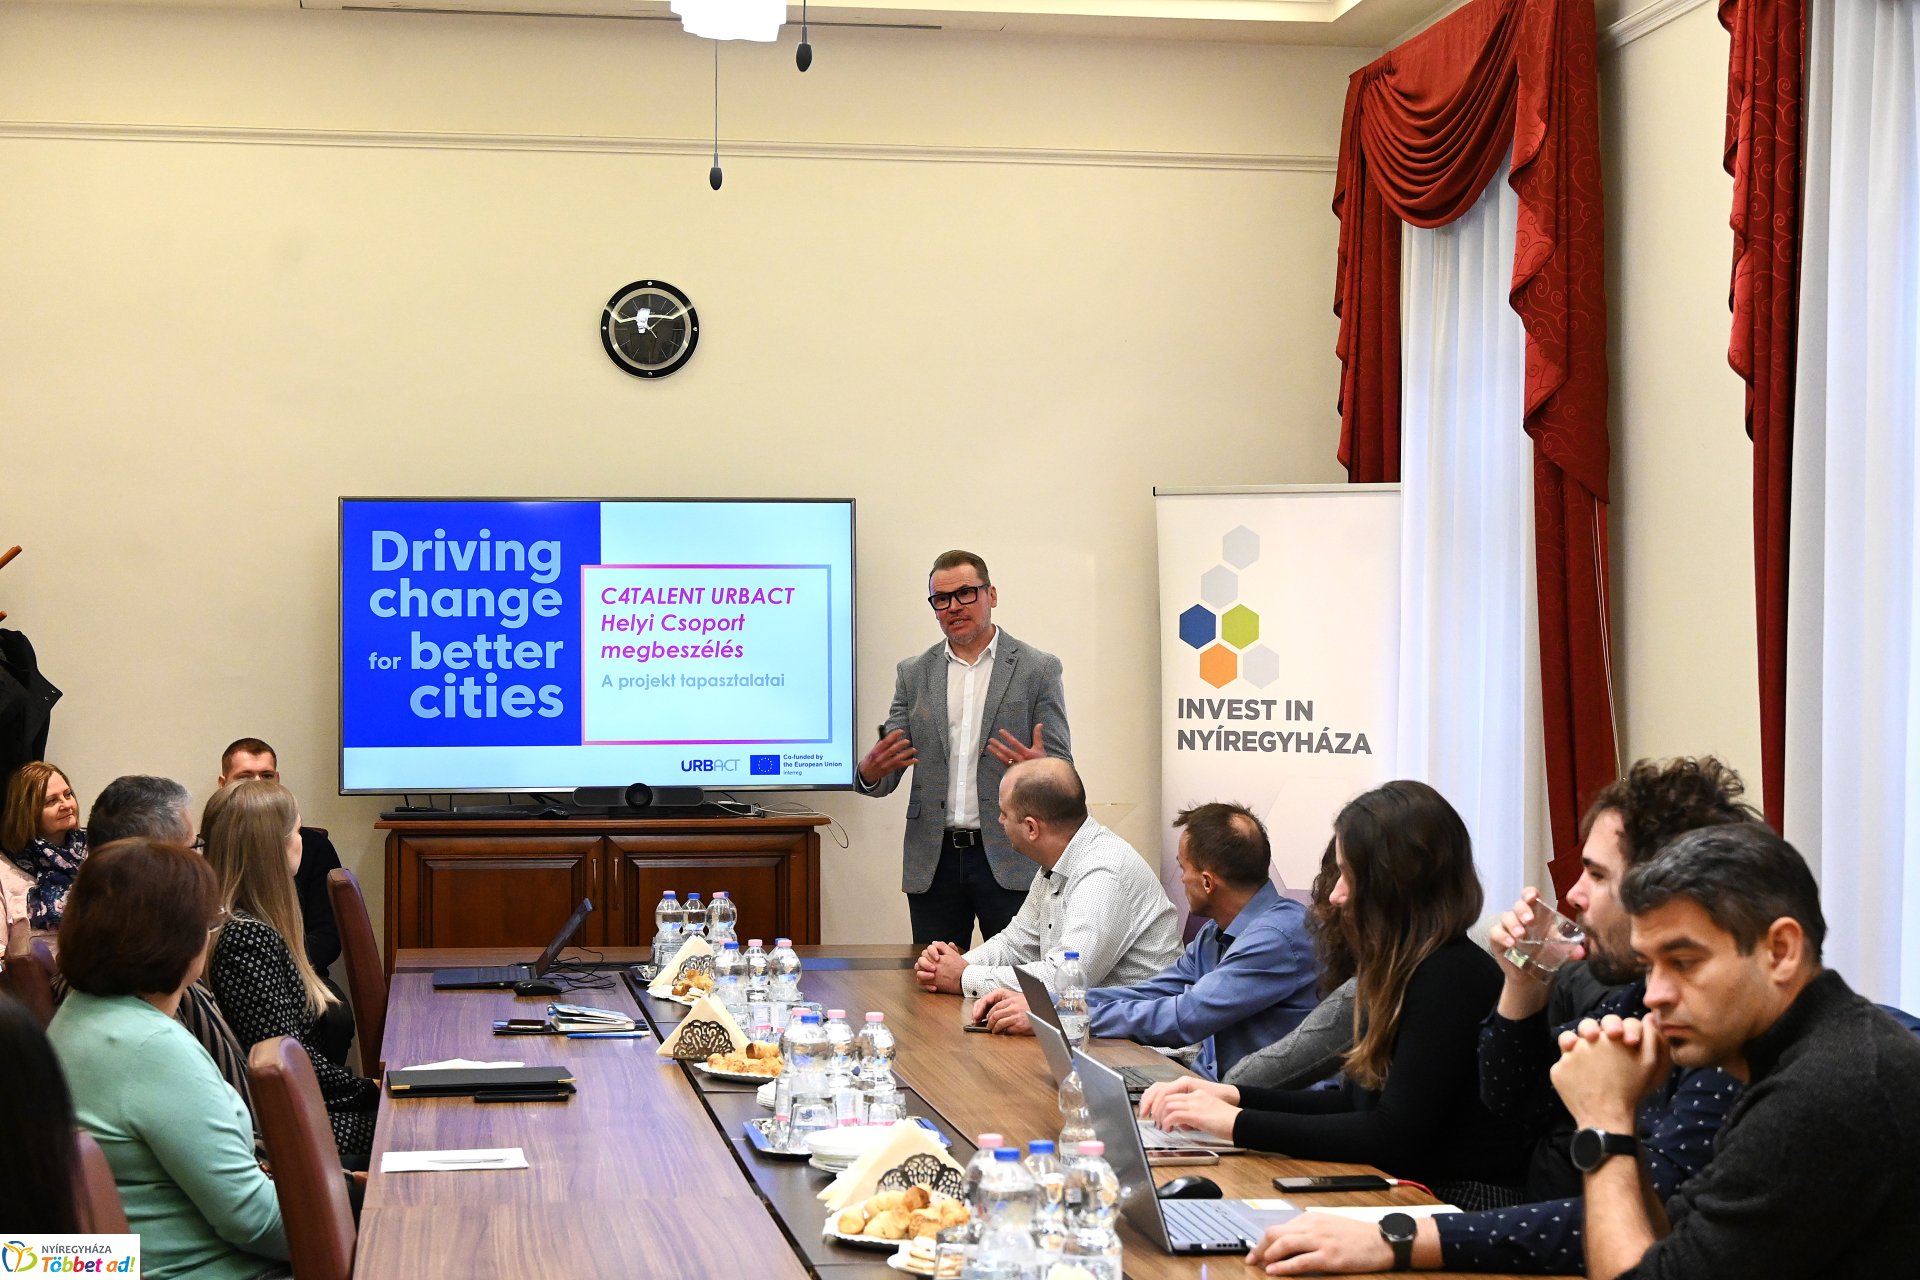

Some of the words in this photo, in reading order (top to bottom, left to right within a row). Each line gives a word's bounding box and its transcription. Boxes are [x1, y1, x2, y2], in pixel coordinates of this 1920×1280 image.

[372, 528, 561, 584] Driving
[369, 577, 563, 629] change
[601, 587, 706, 605] C4TALENT
[711, 587, 796, 605] URBACT
[601, 613, 655, 636] Helyi
[661, 613, 746, 636] Csoport
[368, 652, 402, 670] for
[411, 631, 564, 670] better
[601, 639, 744, 663] megbeszélés
[601, 674, 613, 688] A
[618, 673, 676, 690] projekt
[680, 673, 785, 690] tapasztalatai
[409, 672, 564, 719] cities
[1177, 698, 1277, 721] INVEST
[1285, 700, 1314, 721] IN
[1177, 725, 1373, 755] NYÍREGYHÁZA
[681, 759, 740, 772] URBACT
[794, 761, 823, 769] European
[815, 754, 824, 762] by
